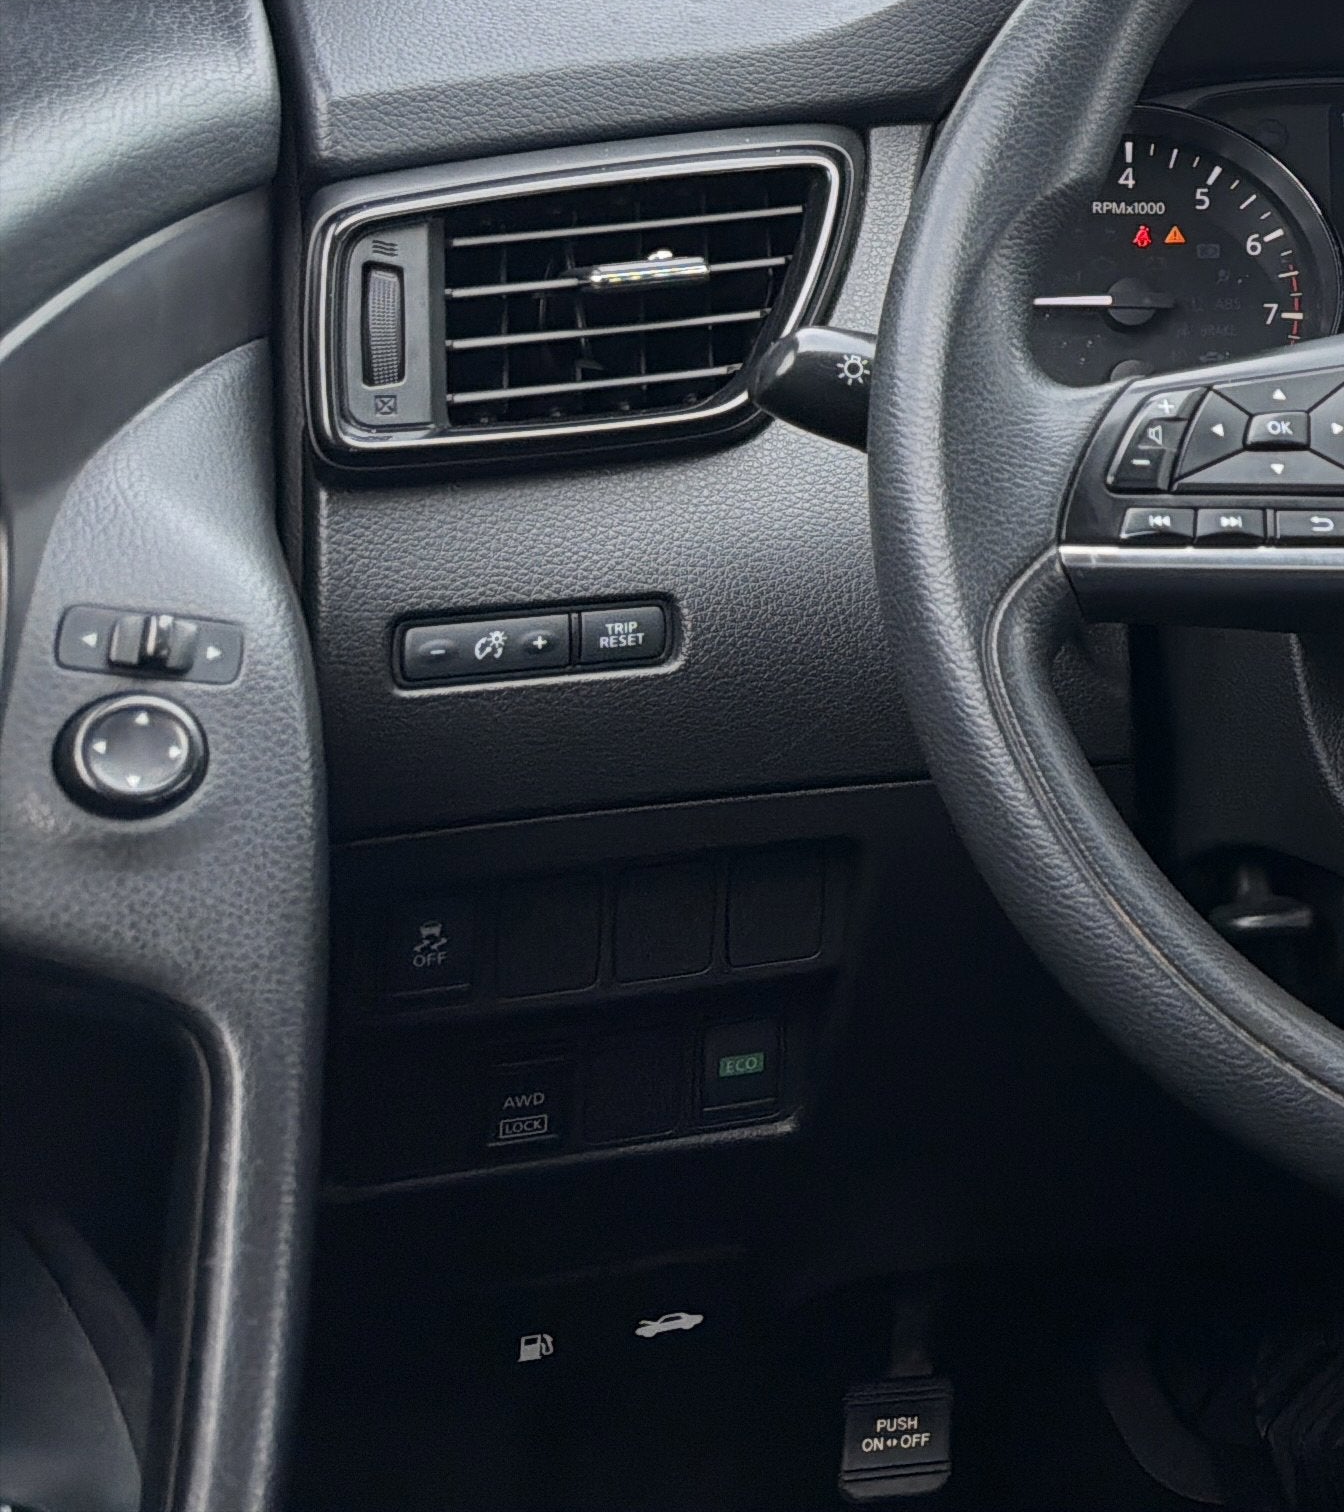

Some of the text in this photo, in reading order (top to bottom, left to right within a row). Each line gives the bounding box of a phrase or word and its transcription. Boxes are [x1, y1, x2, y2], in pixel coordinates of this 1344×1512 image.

[1117, 167, 1136, 189] 4
[1194, 187, 1211, 210] 5
[1091, 201, 1166, 215] RPMx1000
[1245, 233, 1263, 256] 6
[1262, 303, 1279, 325] 7
[1265, 420, 1294, 436] OK
[605, 621, 638, 634] TRIP
[599, 632, 645, 649] RESET
[412, 951, 448, 968] OFF
[725, 1056, 759, 1074] ECO
[502, 1091, 546, 1110] AWD
[503, 1119, 543, 1135] LOCK
[876, 1415, 919, 1433] PUSH
[861, 1432, 931, 1453] ON OFF
